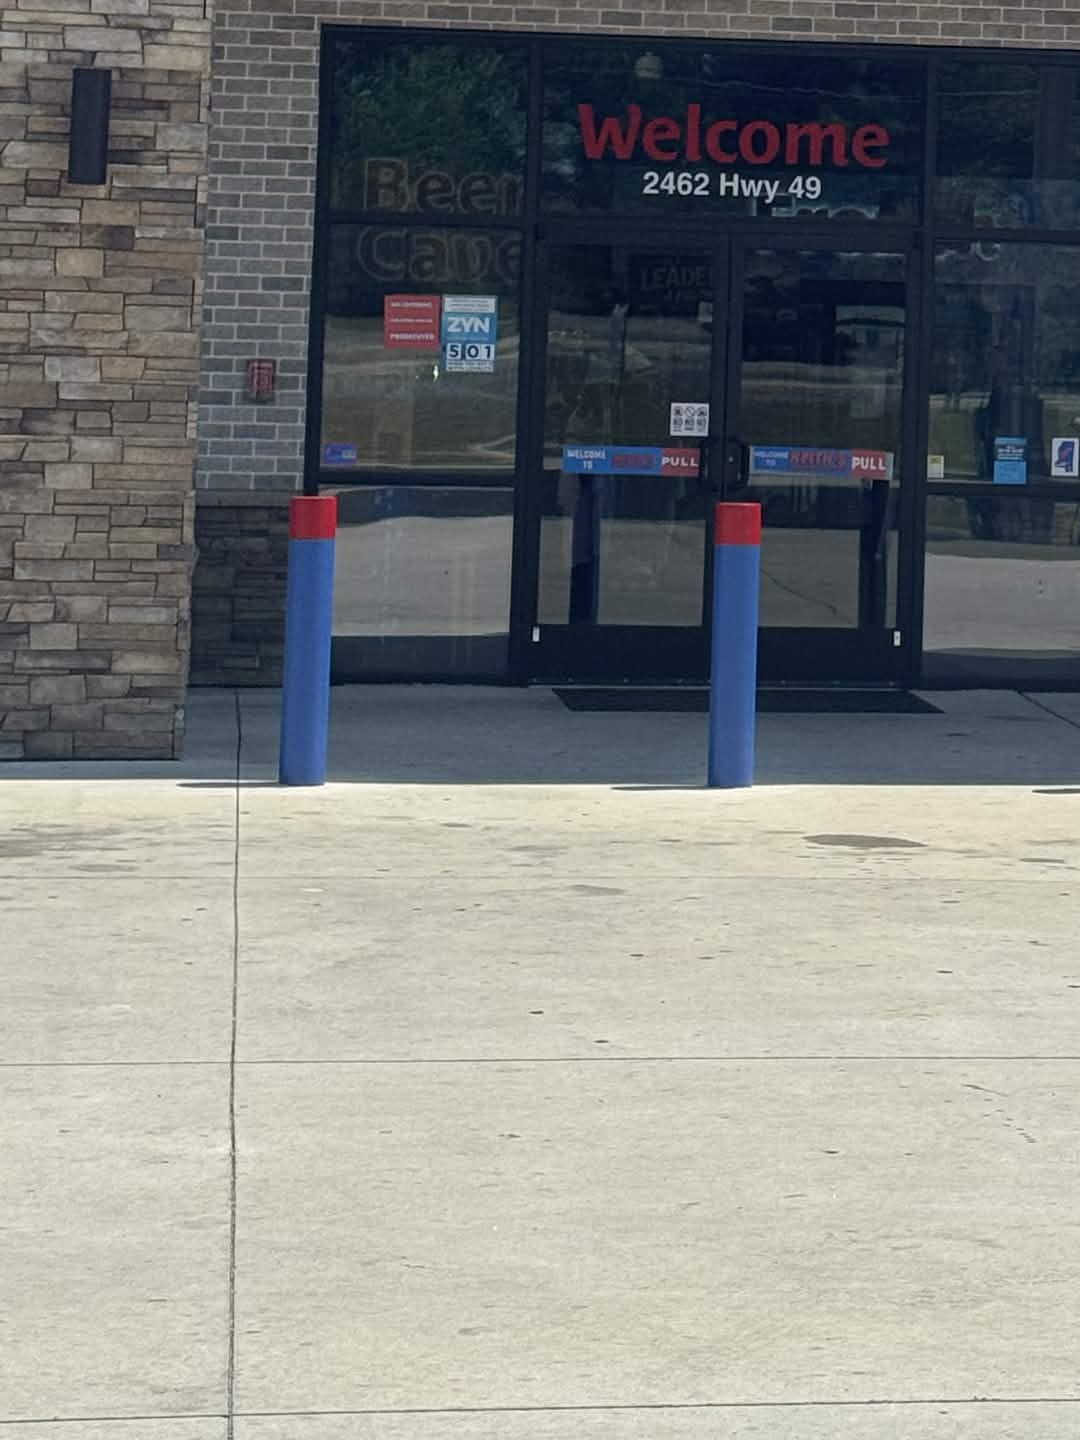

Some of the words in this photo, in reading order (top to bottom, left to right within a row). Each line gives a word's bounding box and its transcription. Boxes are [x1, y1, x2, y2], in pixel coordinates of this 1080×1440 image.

[577, 104, 889, 167] Welcome
[642, 171, 710, 196] 2462
[719, 172, 779, 204] Hwy
[788, 175, 822, 199] 49
[446, 316, 491, 334] ZYN
[567, 449, 605, 459] WELCOME
[661, 456, 699, 468] PULL
[852, 456, 887, 471] PULL
